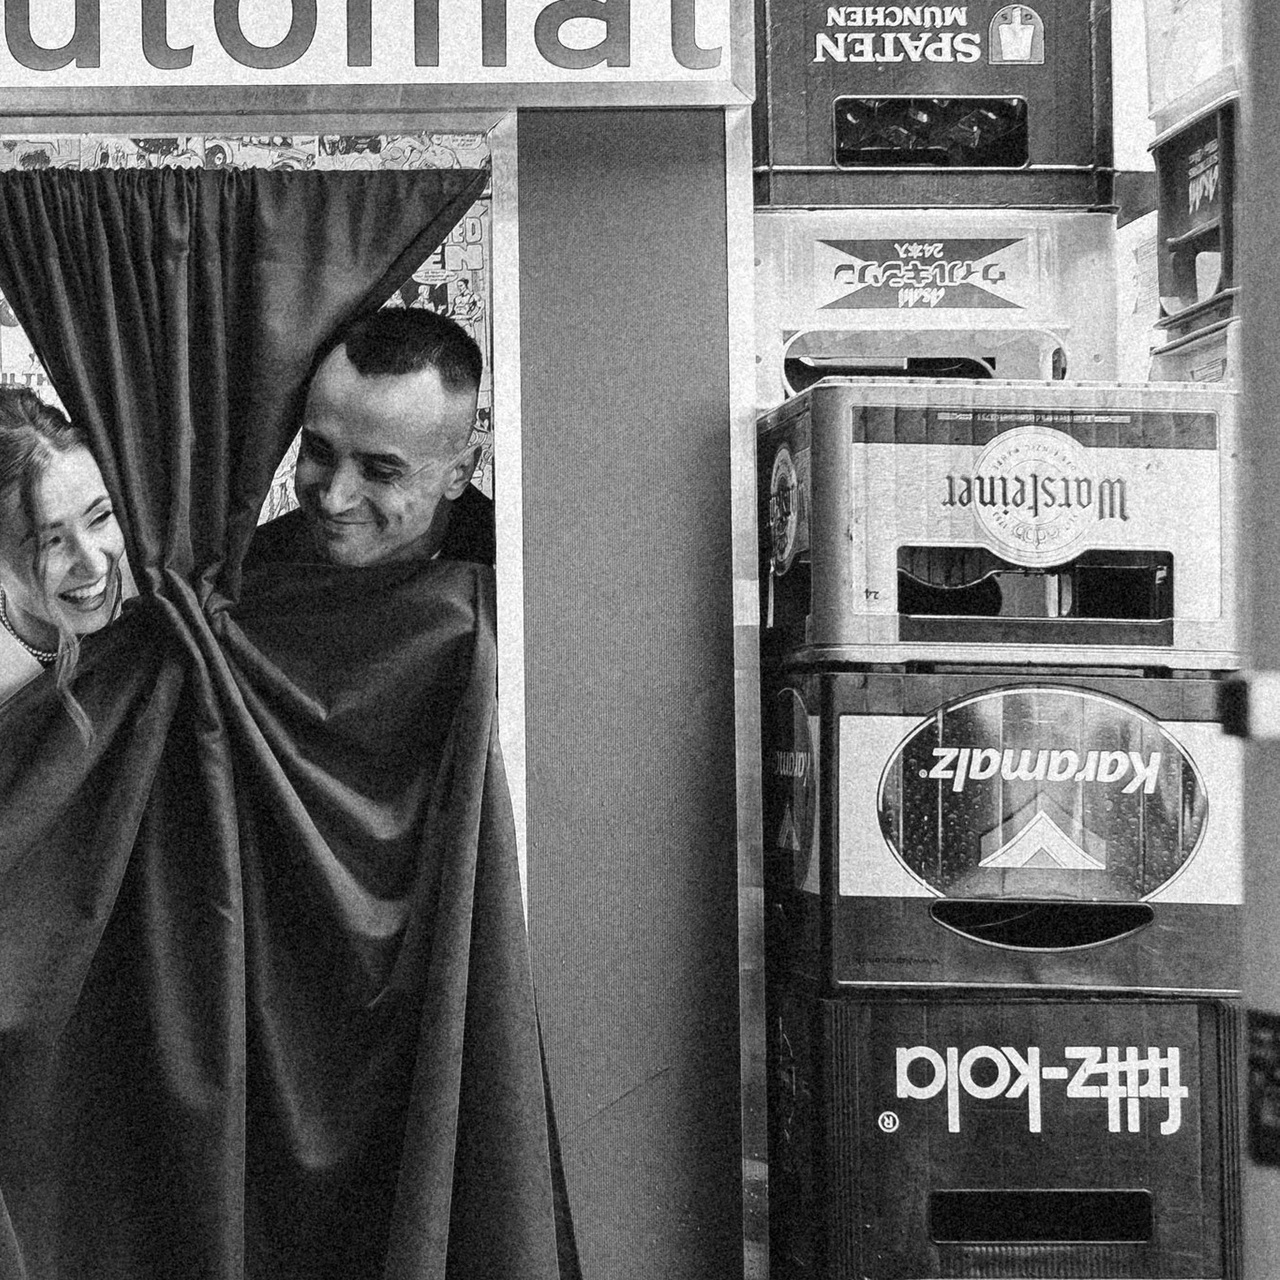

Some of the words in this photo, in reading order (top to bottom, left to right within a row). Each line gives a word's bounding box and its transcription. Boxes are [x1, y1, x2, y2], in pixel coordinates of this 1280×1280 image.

[826, 5, 968, 28] MÜNCHEN
[812, 33, 982, 63] SPATEN
[833, 261, 1006, 286] ウィルキンソン
[898, 287, 946, 308] Asahi
[941, 473, 1129, 522] Warsteiner
[928, 746, 1162, 795] Karamalz
[896, 1045, 1188, 1135] fritz-kola
